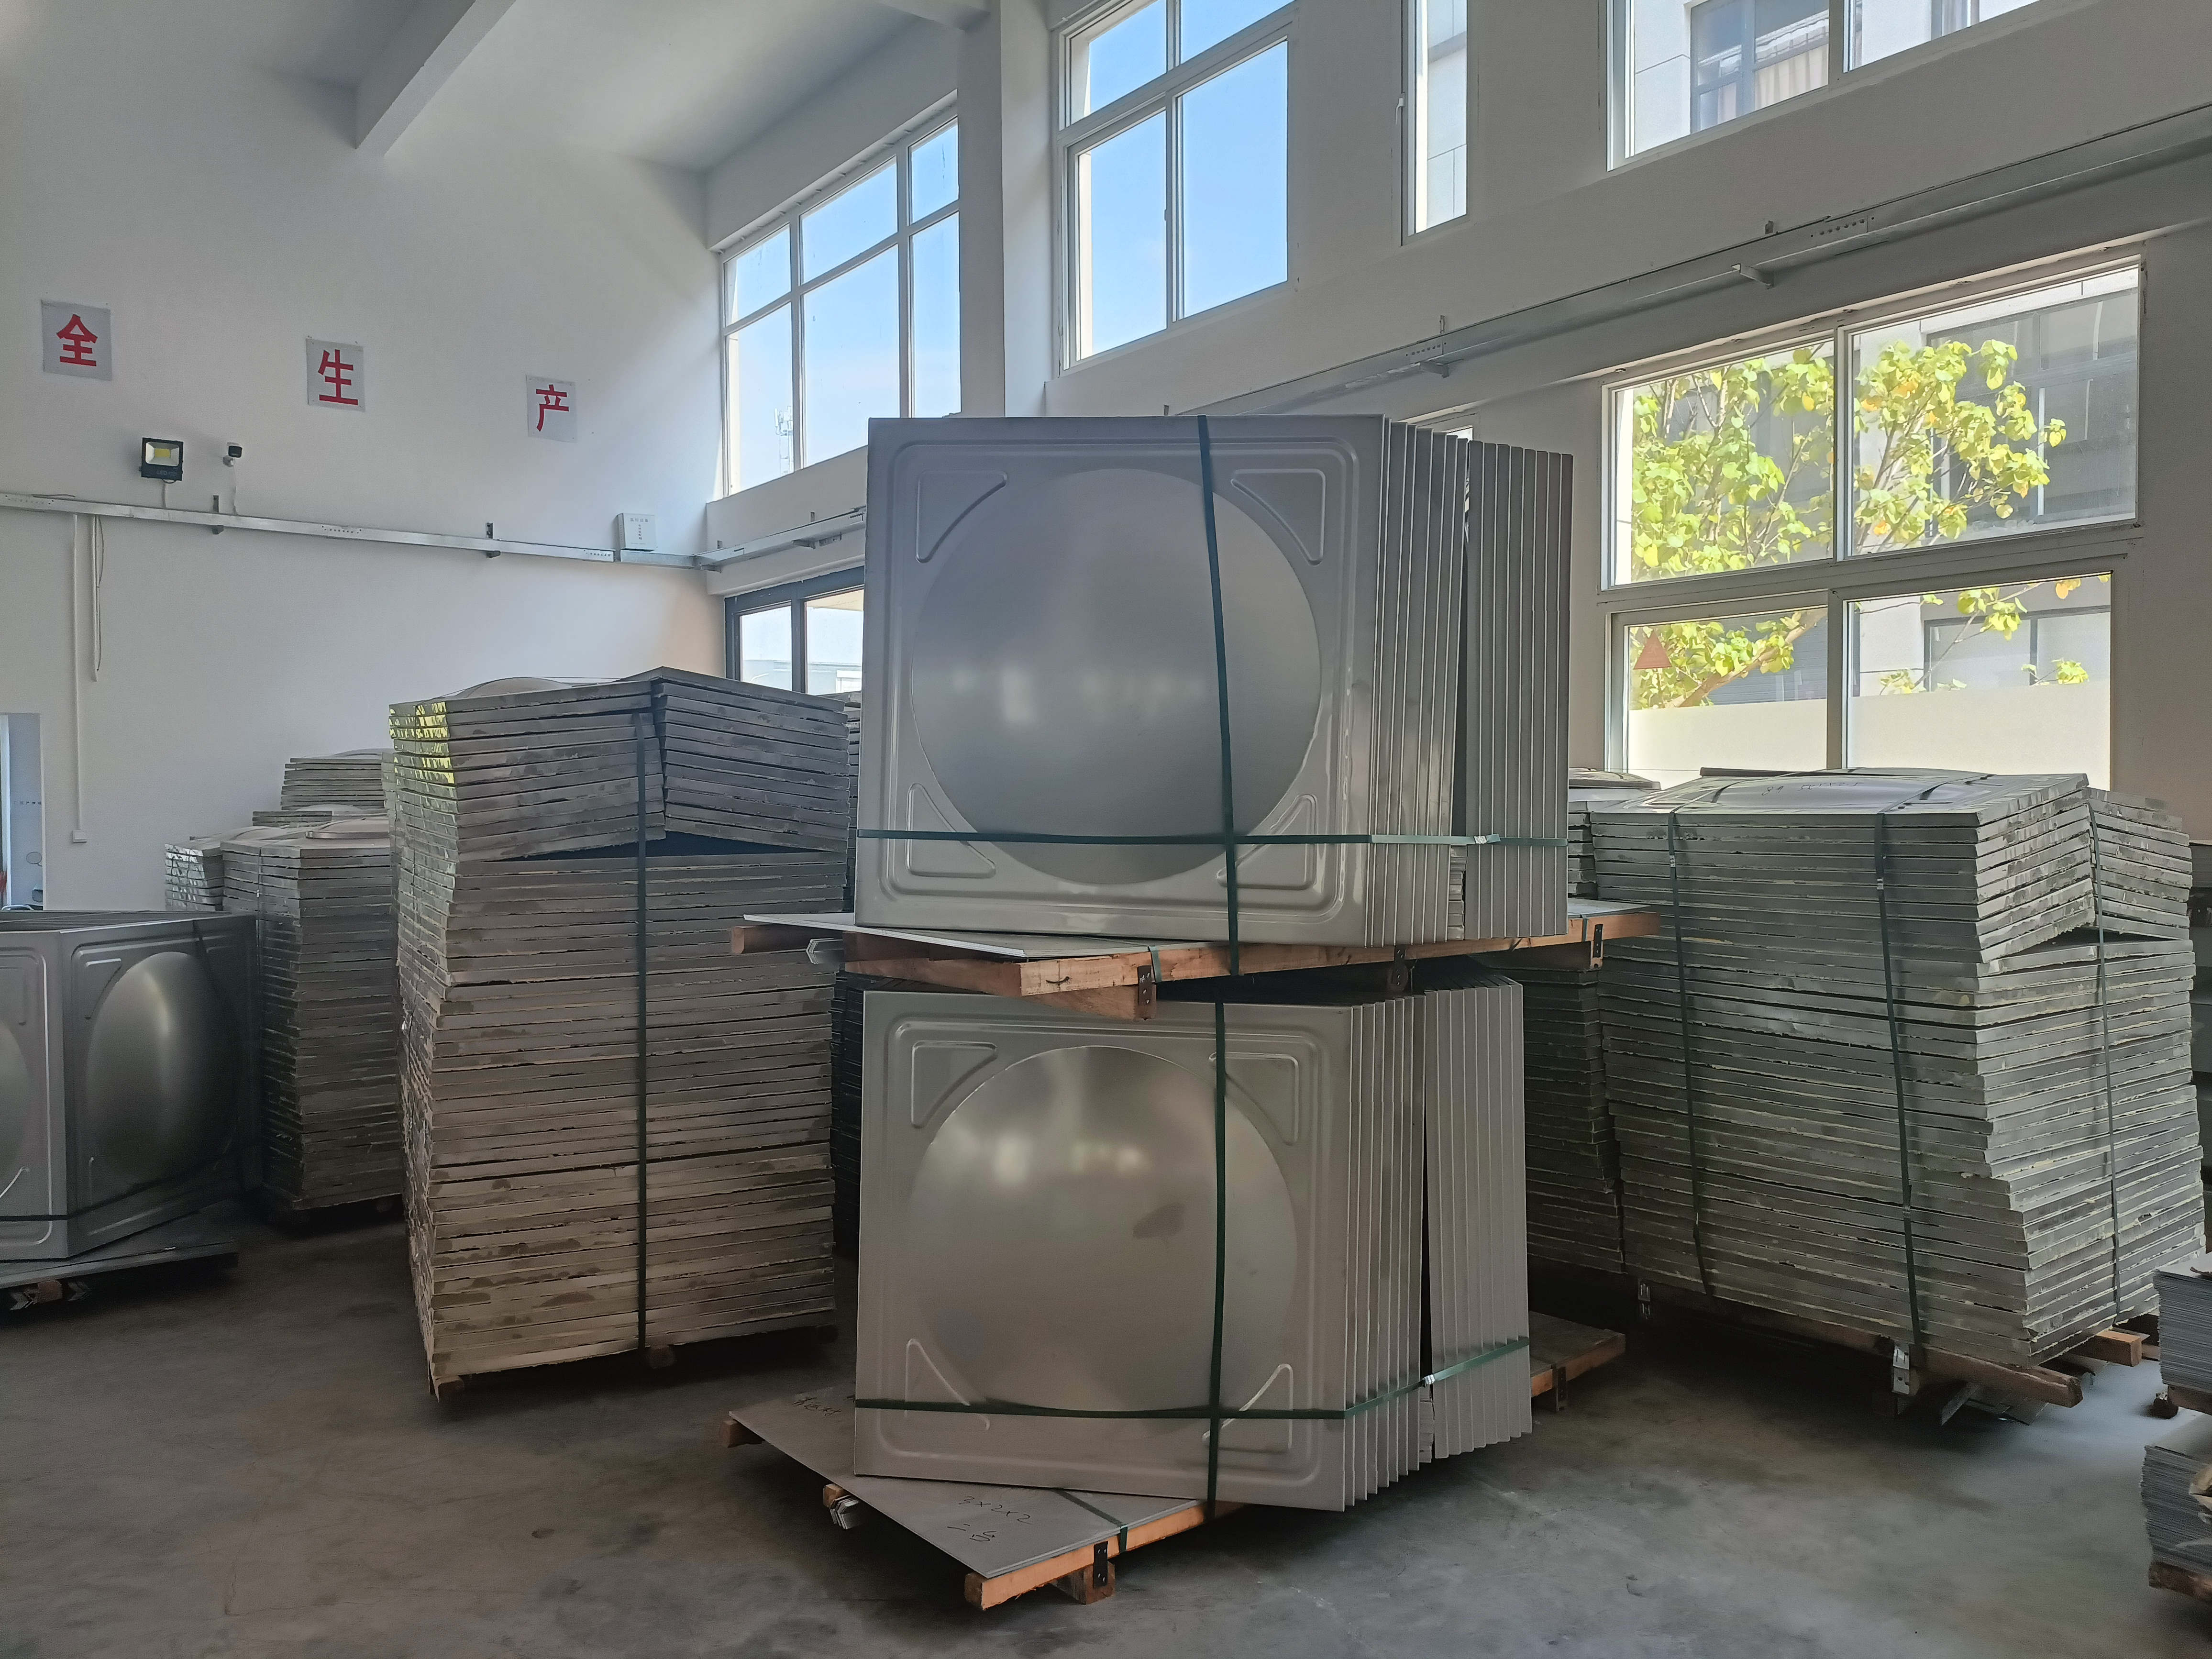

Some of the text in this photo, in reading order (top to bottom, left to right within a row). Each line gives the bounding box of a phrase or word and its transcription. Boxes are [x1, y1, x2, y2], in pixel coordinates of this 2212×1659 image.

[56, 313, 569, 431] 全 生 产
